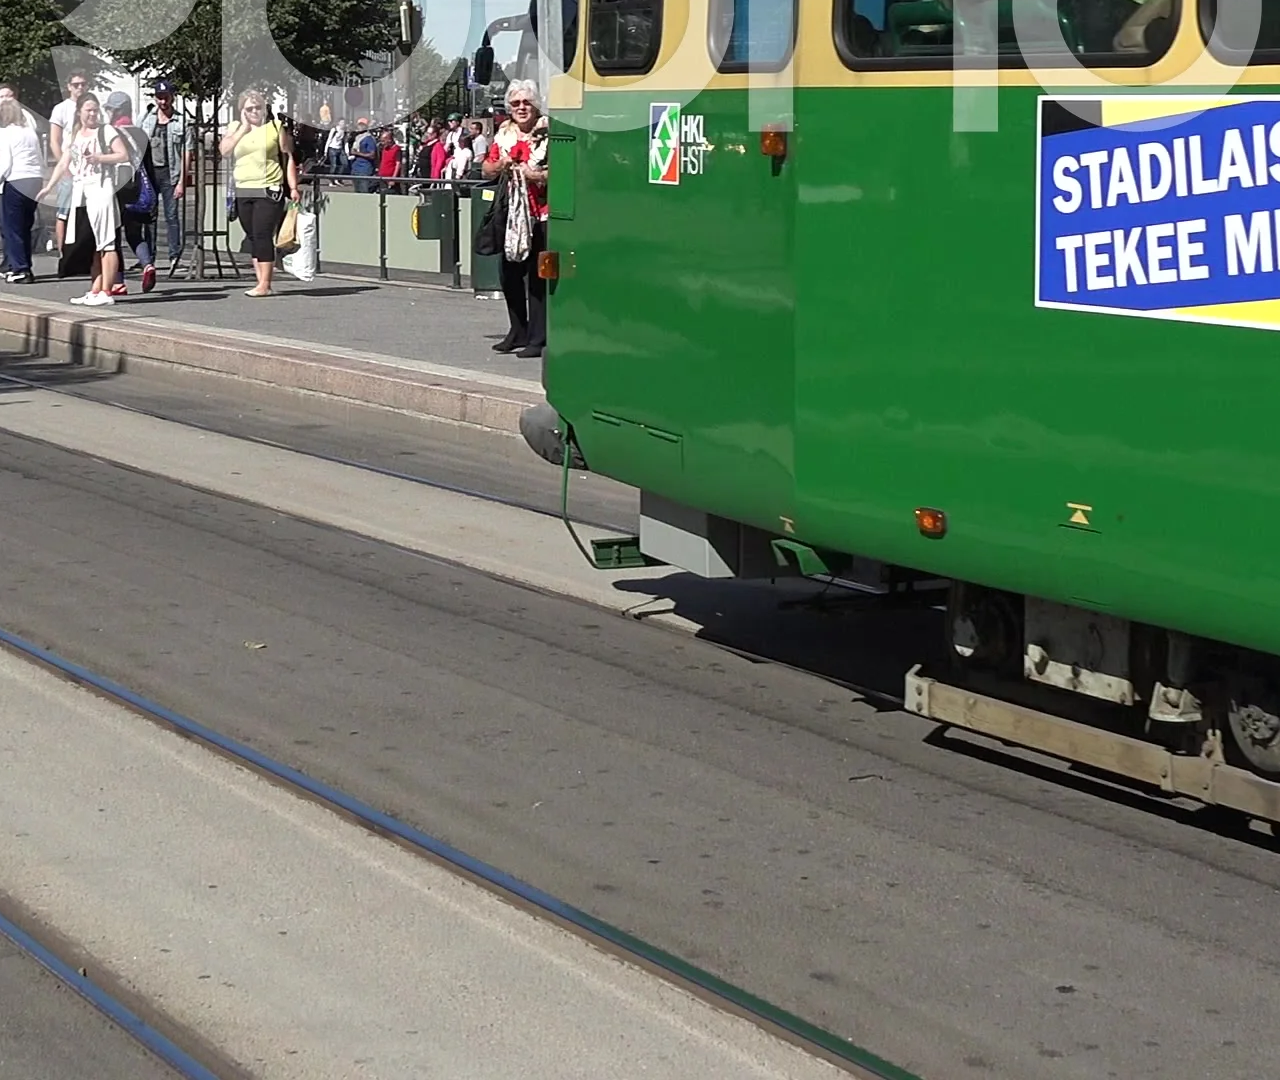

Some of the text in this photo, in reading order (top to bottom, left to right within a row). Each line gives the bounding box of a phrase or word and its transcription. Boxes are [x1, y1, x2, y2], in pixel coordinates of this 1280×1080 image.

[680, 114, 705, 144] HKL
[680, 145, 704, 174] HST
[1055, 218, 1210, 294] TEKEE
